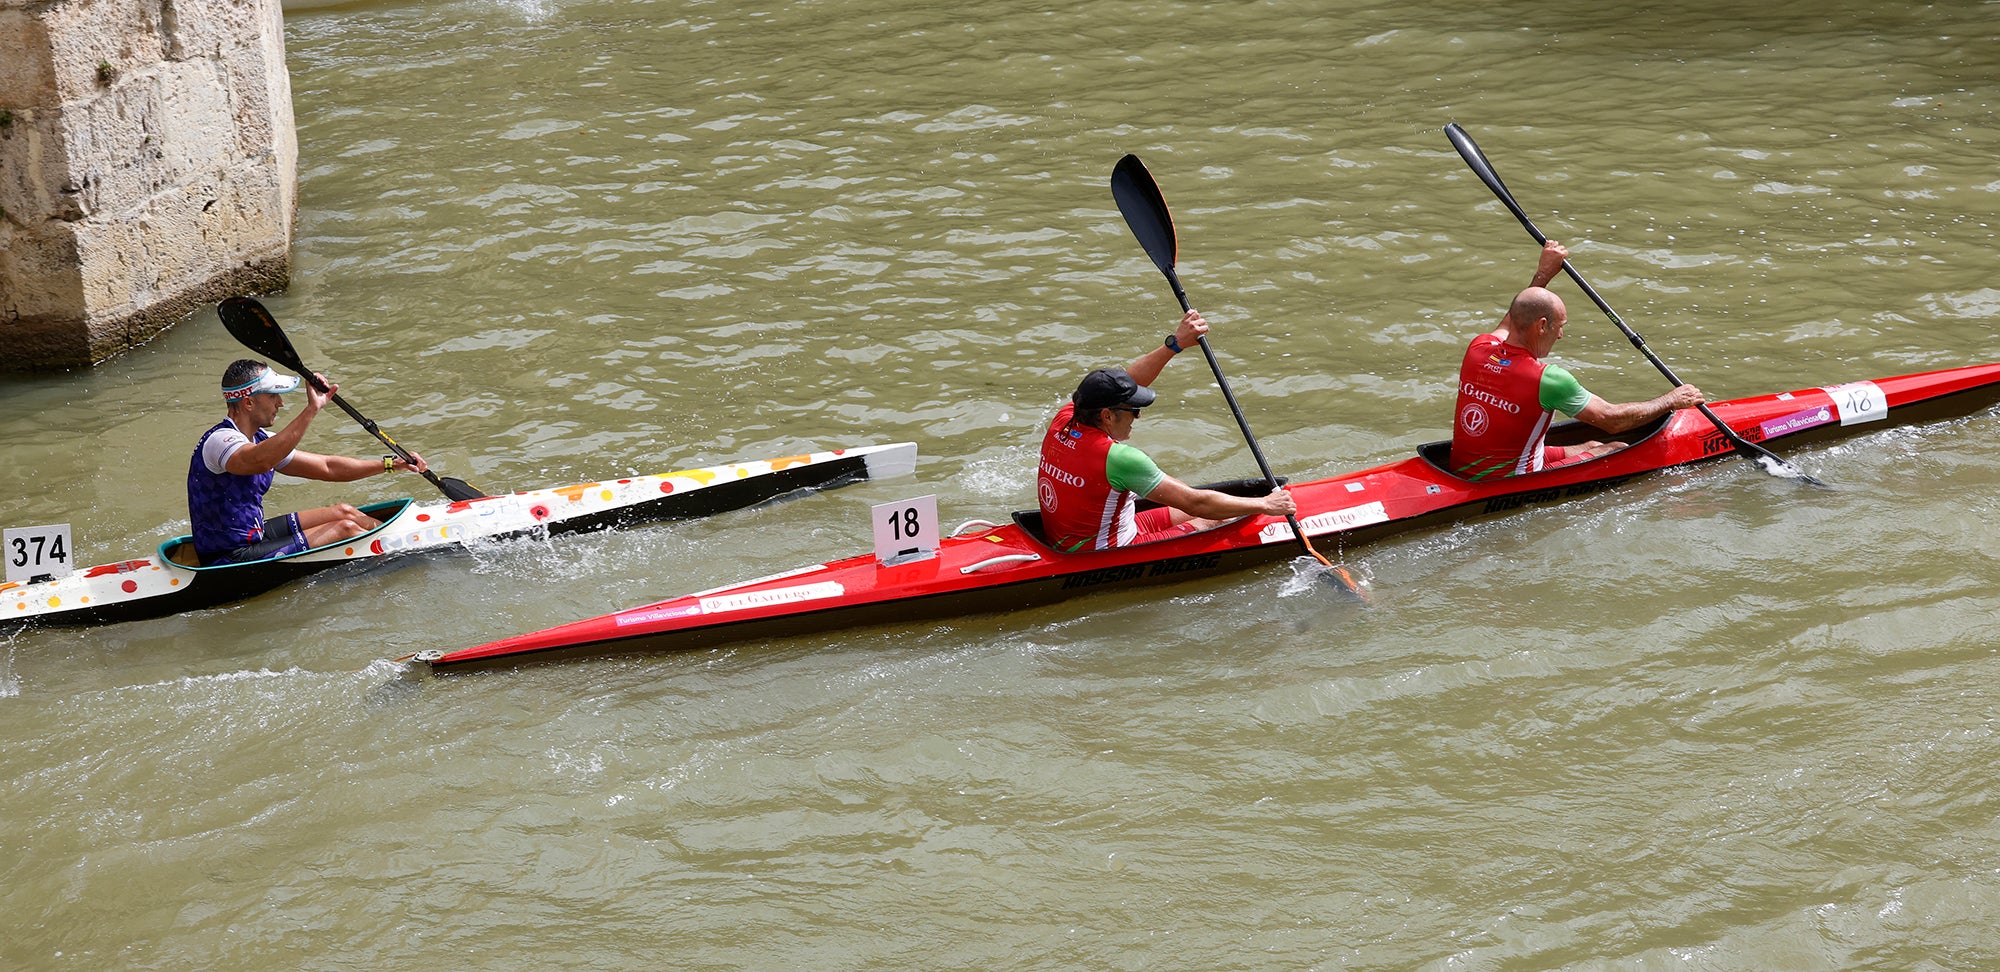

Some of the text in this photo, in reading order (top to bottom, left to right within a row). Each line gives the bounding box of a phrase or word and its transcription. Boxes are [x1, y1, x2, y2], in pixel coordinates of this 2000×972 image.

[1463, 382, 1521, 414] GAITERO
[1845, 389, 1872, 414] 18
[1763, 414, 1820, 435] Turismo Villaviciosa
[888, 507, 920, 540] 18
[12, 534, 67, 567] 374
[618, 615, 647, 624] Turismo
